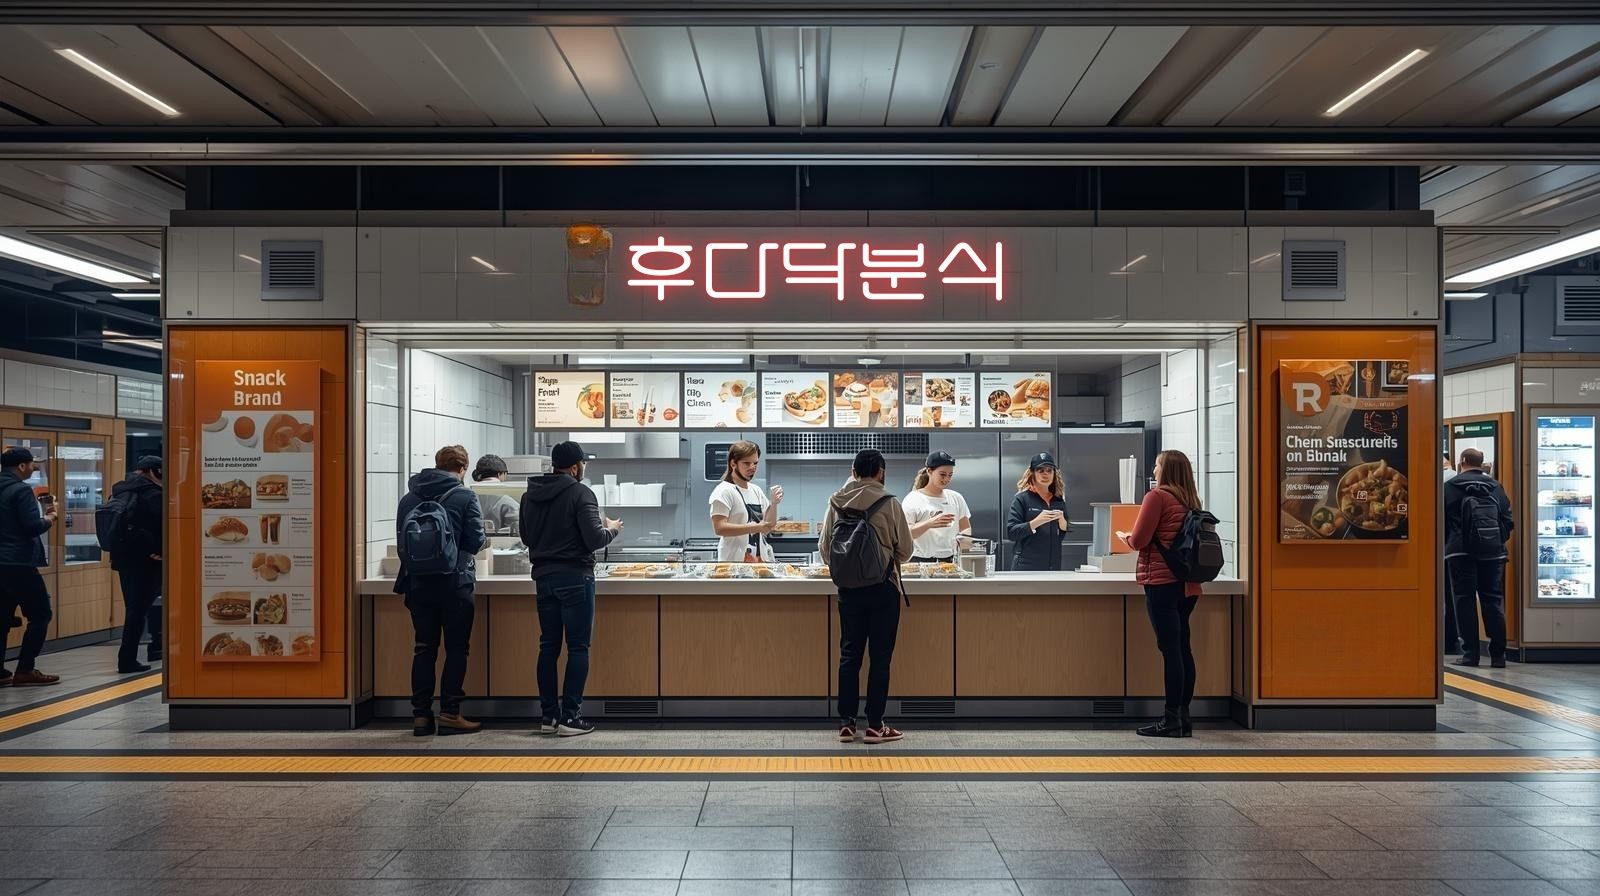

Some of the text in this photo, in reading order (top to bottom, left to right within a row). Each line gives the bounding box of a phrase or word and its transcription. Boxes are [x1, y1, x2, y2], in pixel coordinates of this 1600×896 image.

[627, 236, 1003, 301] 후다닥분식
[234, 369, 287, 386] Snack
[233, 390, 282, 406] Brand
[1286, 435, 1323, 448] Chem
[1286, 451, 1303, 462] on
